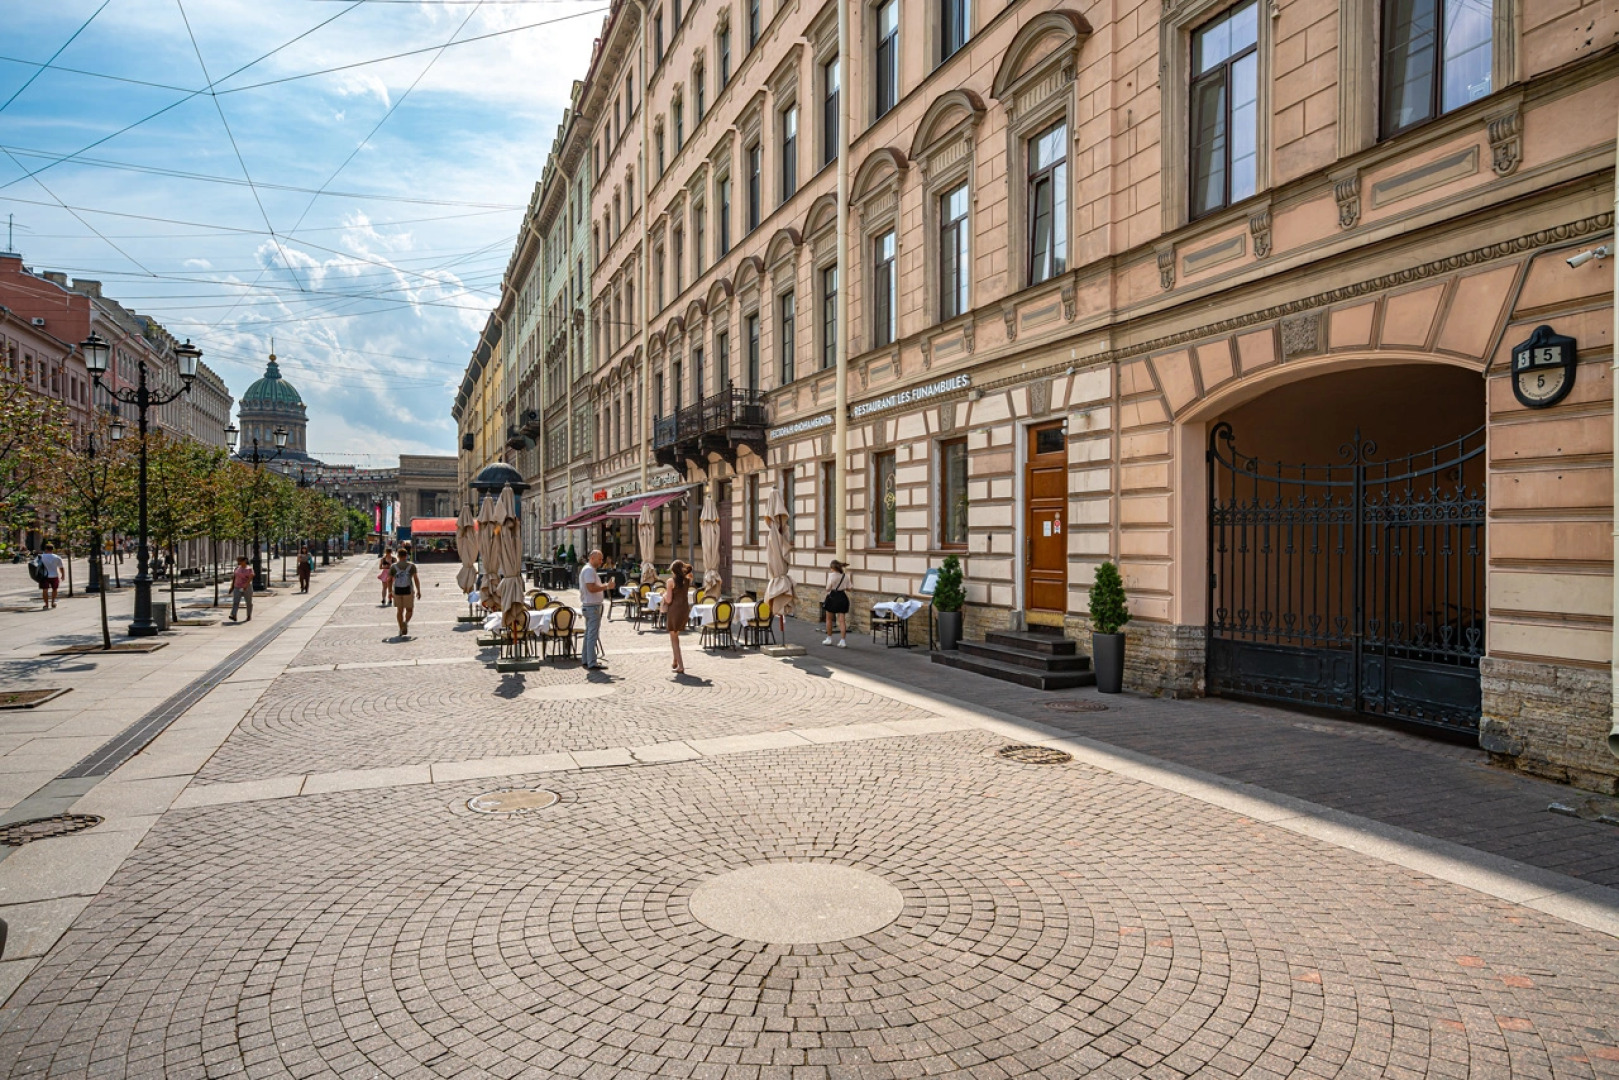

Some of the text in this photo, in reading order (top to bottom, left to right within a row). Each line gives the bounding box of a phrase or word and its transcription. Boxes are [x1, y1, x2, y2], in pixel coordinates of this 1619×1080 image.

[1521, 352, 1526, 366] 5
[1543, 348, 1552, 361] 5
[1537, 374, 1545, 388] 5
[854, 374, 971, 417] RESTAURANT LES FUNAMBULES
